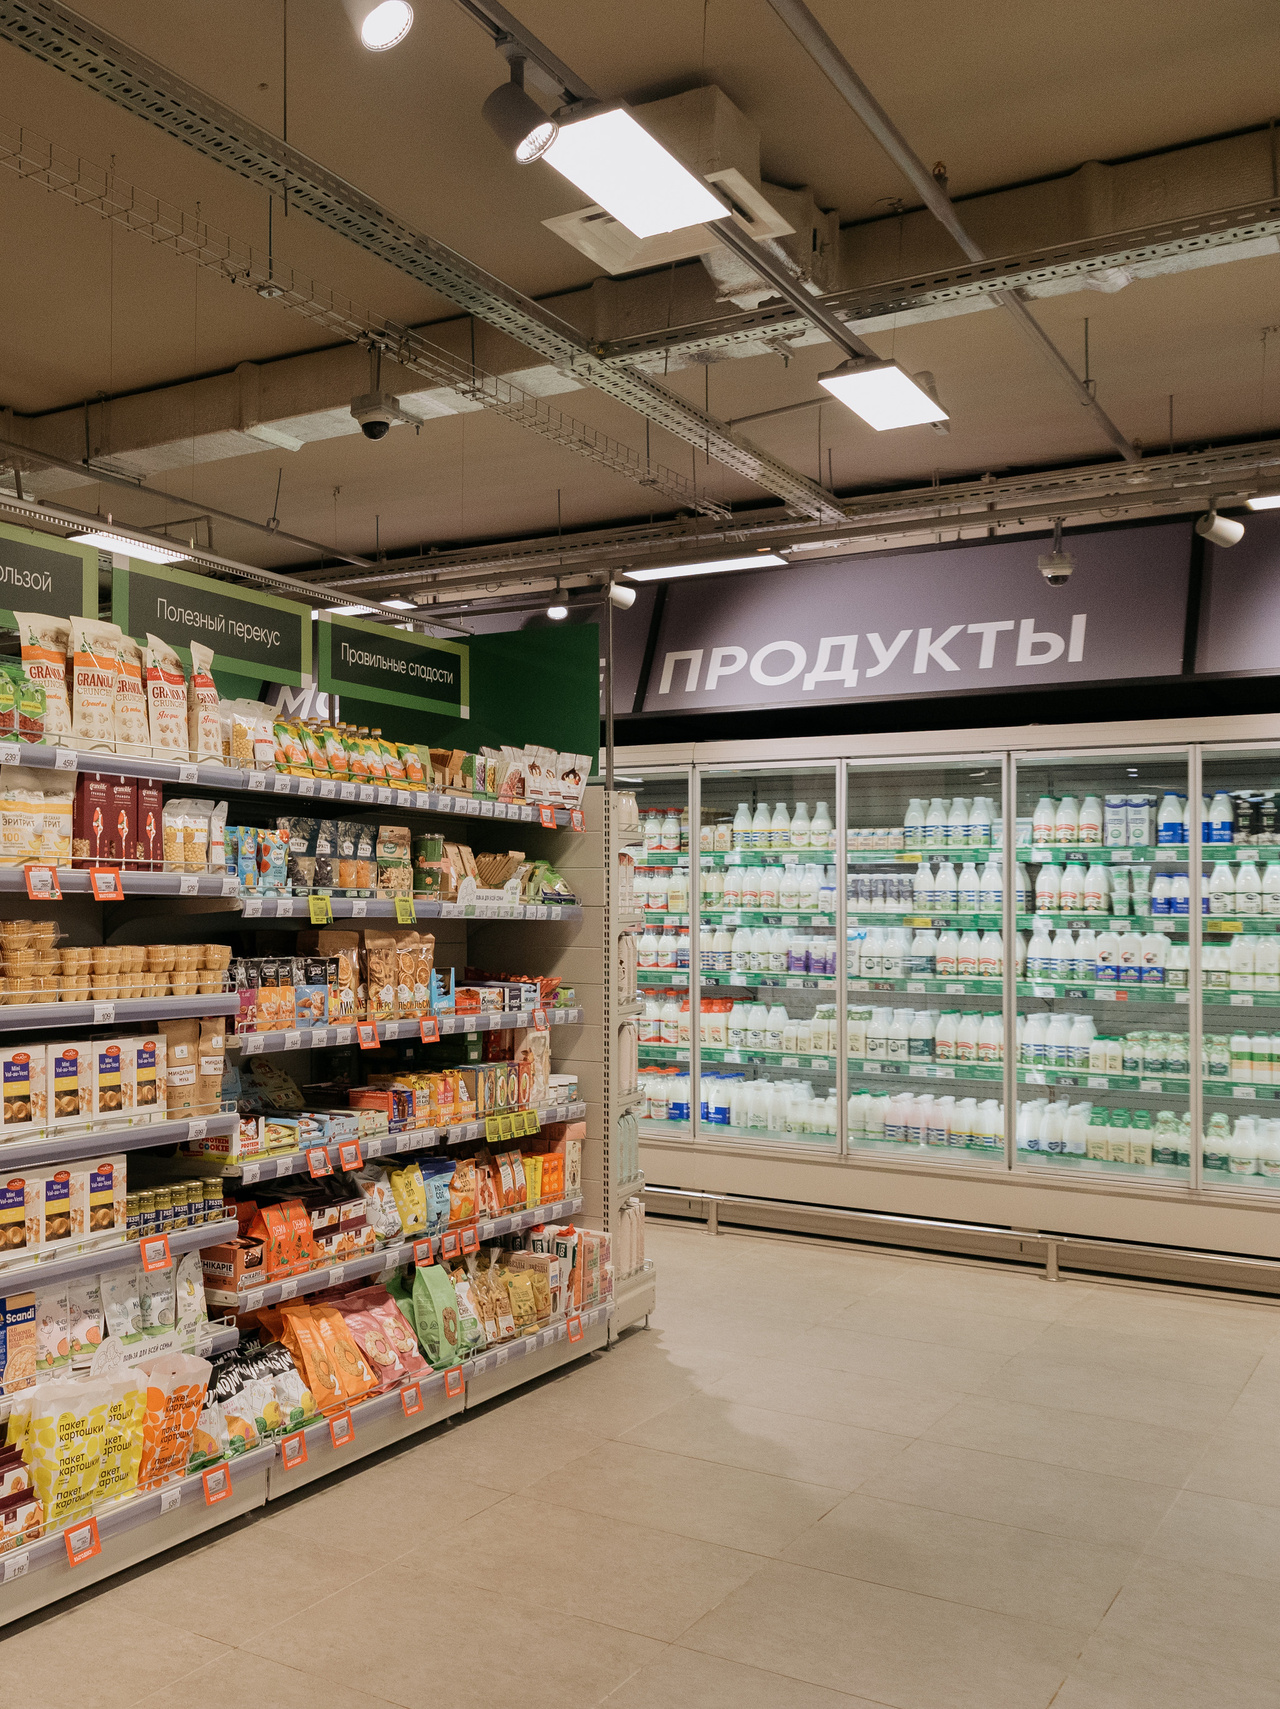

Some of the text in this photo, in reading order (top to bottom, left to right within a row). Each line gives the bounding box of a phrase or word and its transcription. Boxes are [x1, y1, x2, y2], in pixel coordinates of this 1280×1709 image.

[157, 598, 281, 648] Полезный перекус
[658, 613, 1087, 695] ПРОДУКТЫ
[341, 642, 454, 685] Правильные сладости
[152, 685, 186, 700] GRANOLA
[2, 818, 35, 828] ЭРИТРИТ
[6, 1308, 35, 1324] Scandi
[165, 1399, 201, 1413] картошки
[167, 1394, 189, 1404] пакет
[59, 1418, 85, 1432] пакет
[59, 1424, 104, 1442] картошки
[59, 1453, 85, 1468] пакет
[59, 1457, 100, 1477] картошки
[55, 1490, 94, 1509] картошки
[56, 1486, 82, 1500] пакет
